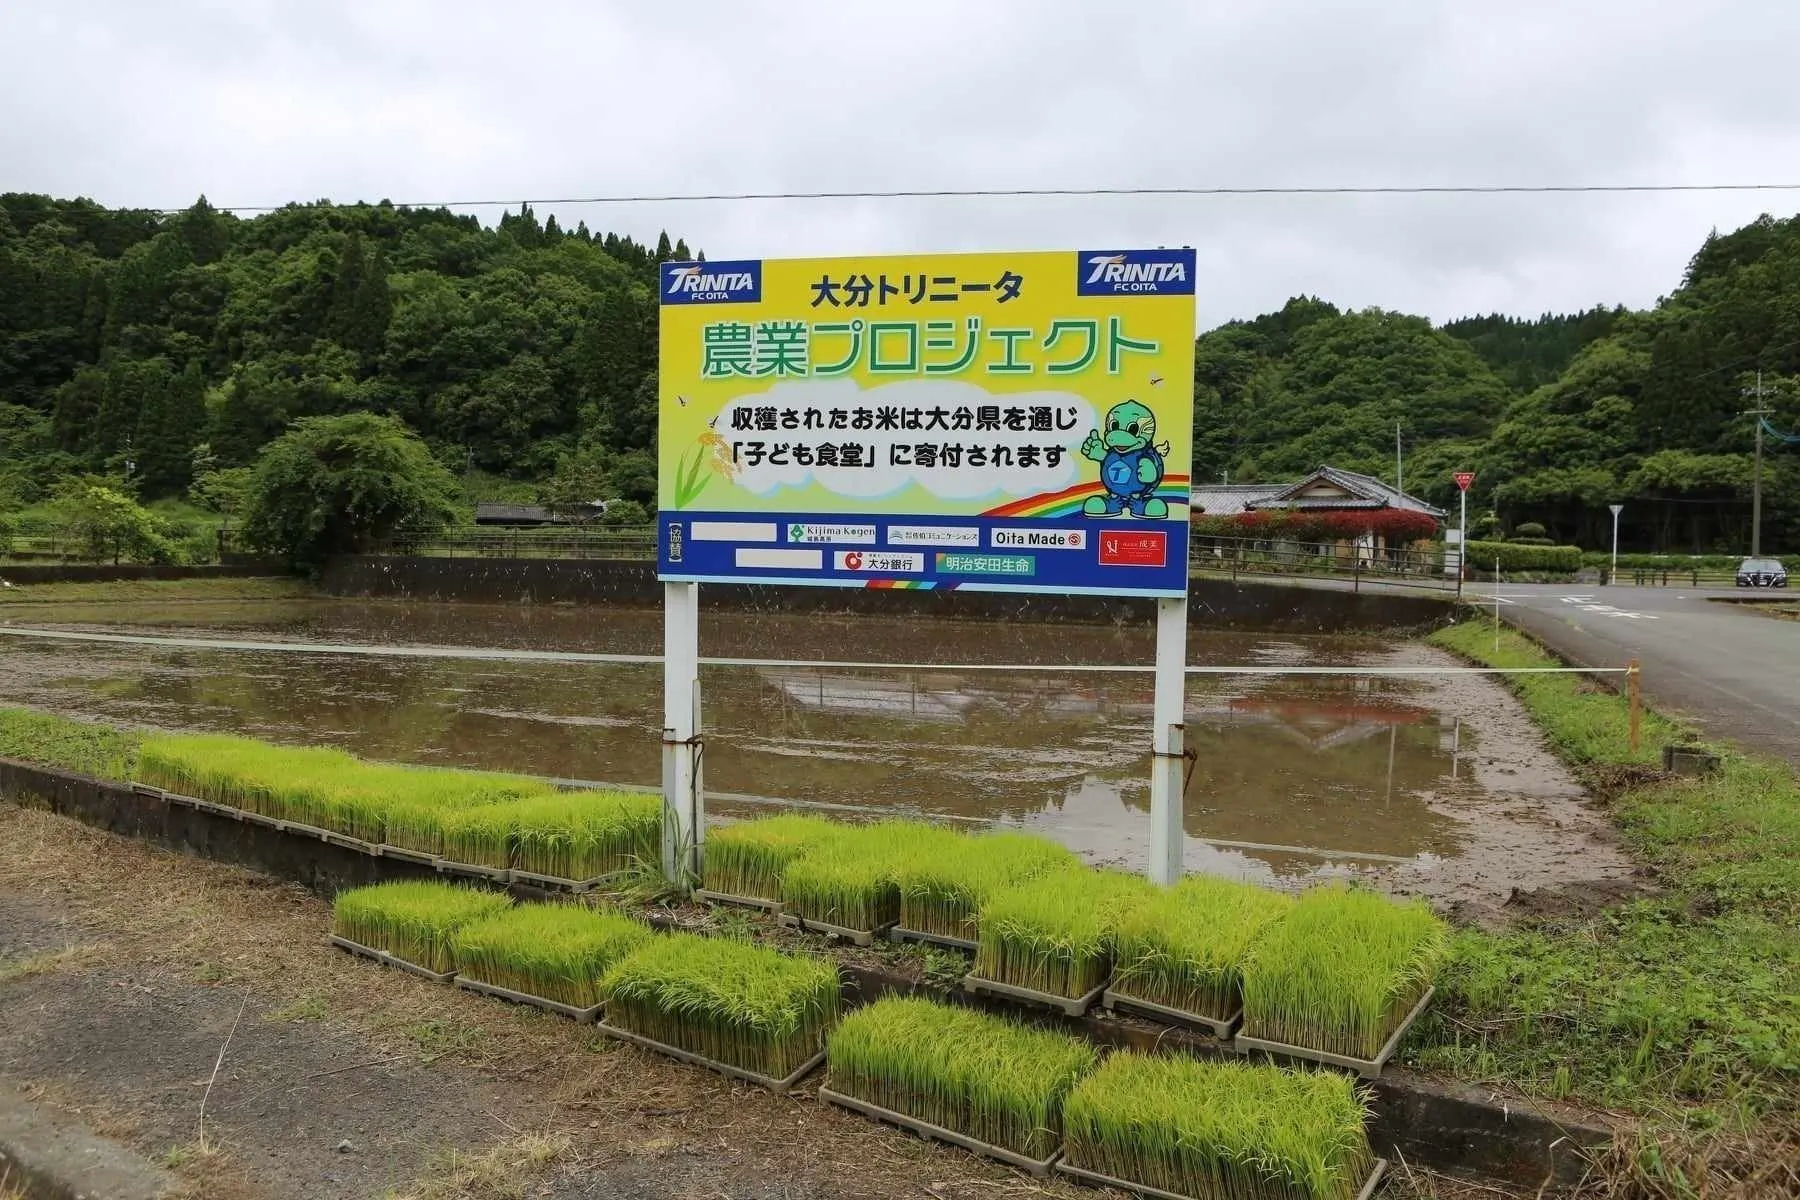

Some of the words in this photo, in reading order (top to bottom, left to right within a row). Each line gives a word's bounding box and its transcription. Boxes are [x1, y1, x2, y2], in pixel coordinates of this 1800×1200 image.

[667, 265, 753, 294] TRINITA
[1087, 255, 1186, 285] TRINITA
[706, 292, 729, 300] OITA
[811, 270, 1023, 307] 大分トリニータ
[1114, 283, 1129, 292] FC
[1130, 282, 1158, 291] OITA
[702, 317, 1158, 377] 農業プロジェクト
[731, 405, 1078, 431] 収穫されたお米は大分県を通じ
[733, 441, 1067, 468] 「子ども食堂」に寄付されます
[807, 526, 841, 536] Kijima
[996, 532, 1024, 545] Oita
[1028, 532, 1065, 546] Made
[868, 559, 913, 571] 大分銀行
[946, 556, 1029, 572] 明治安田生命
